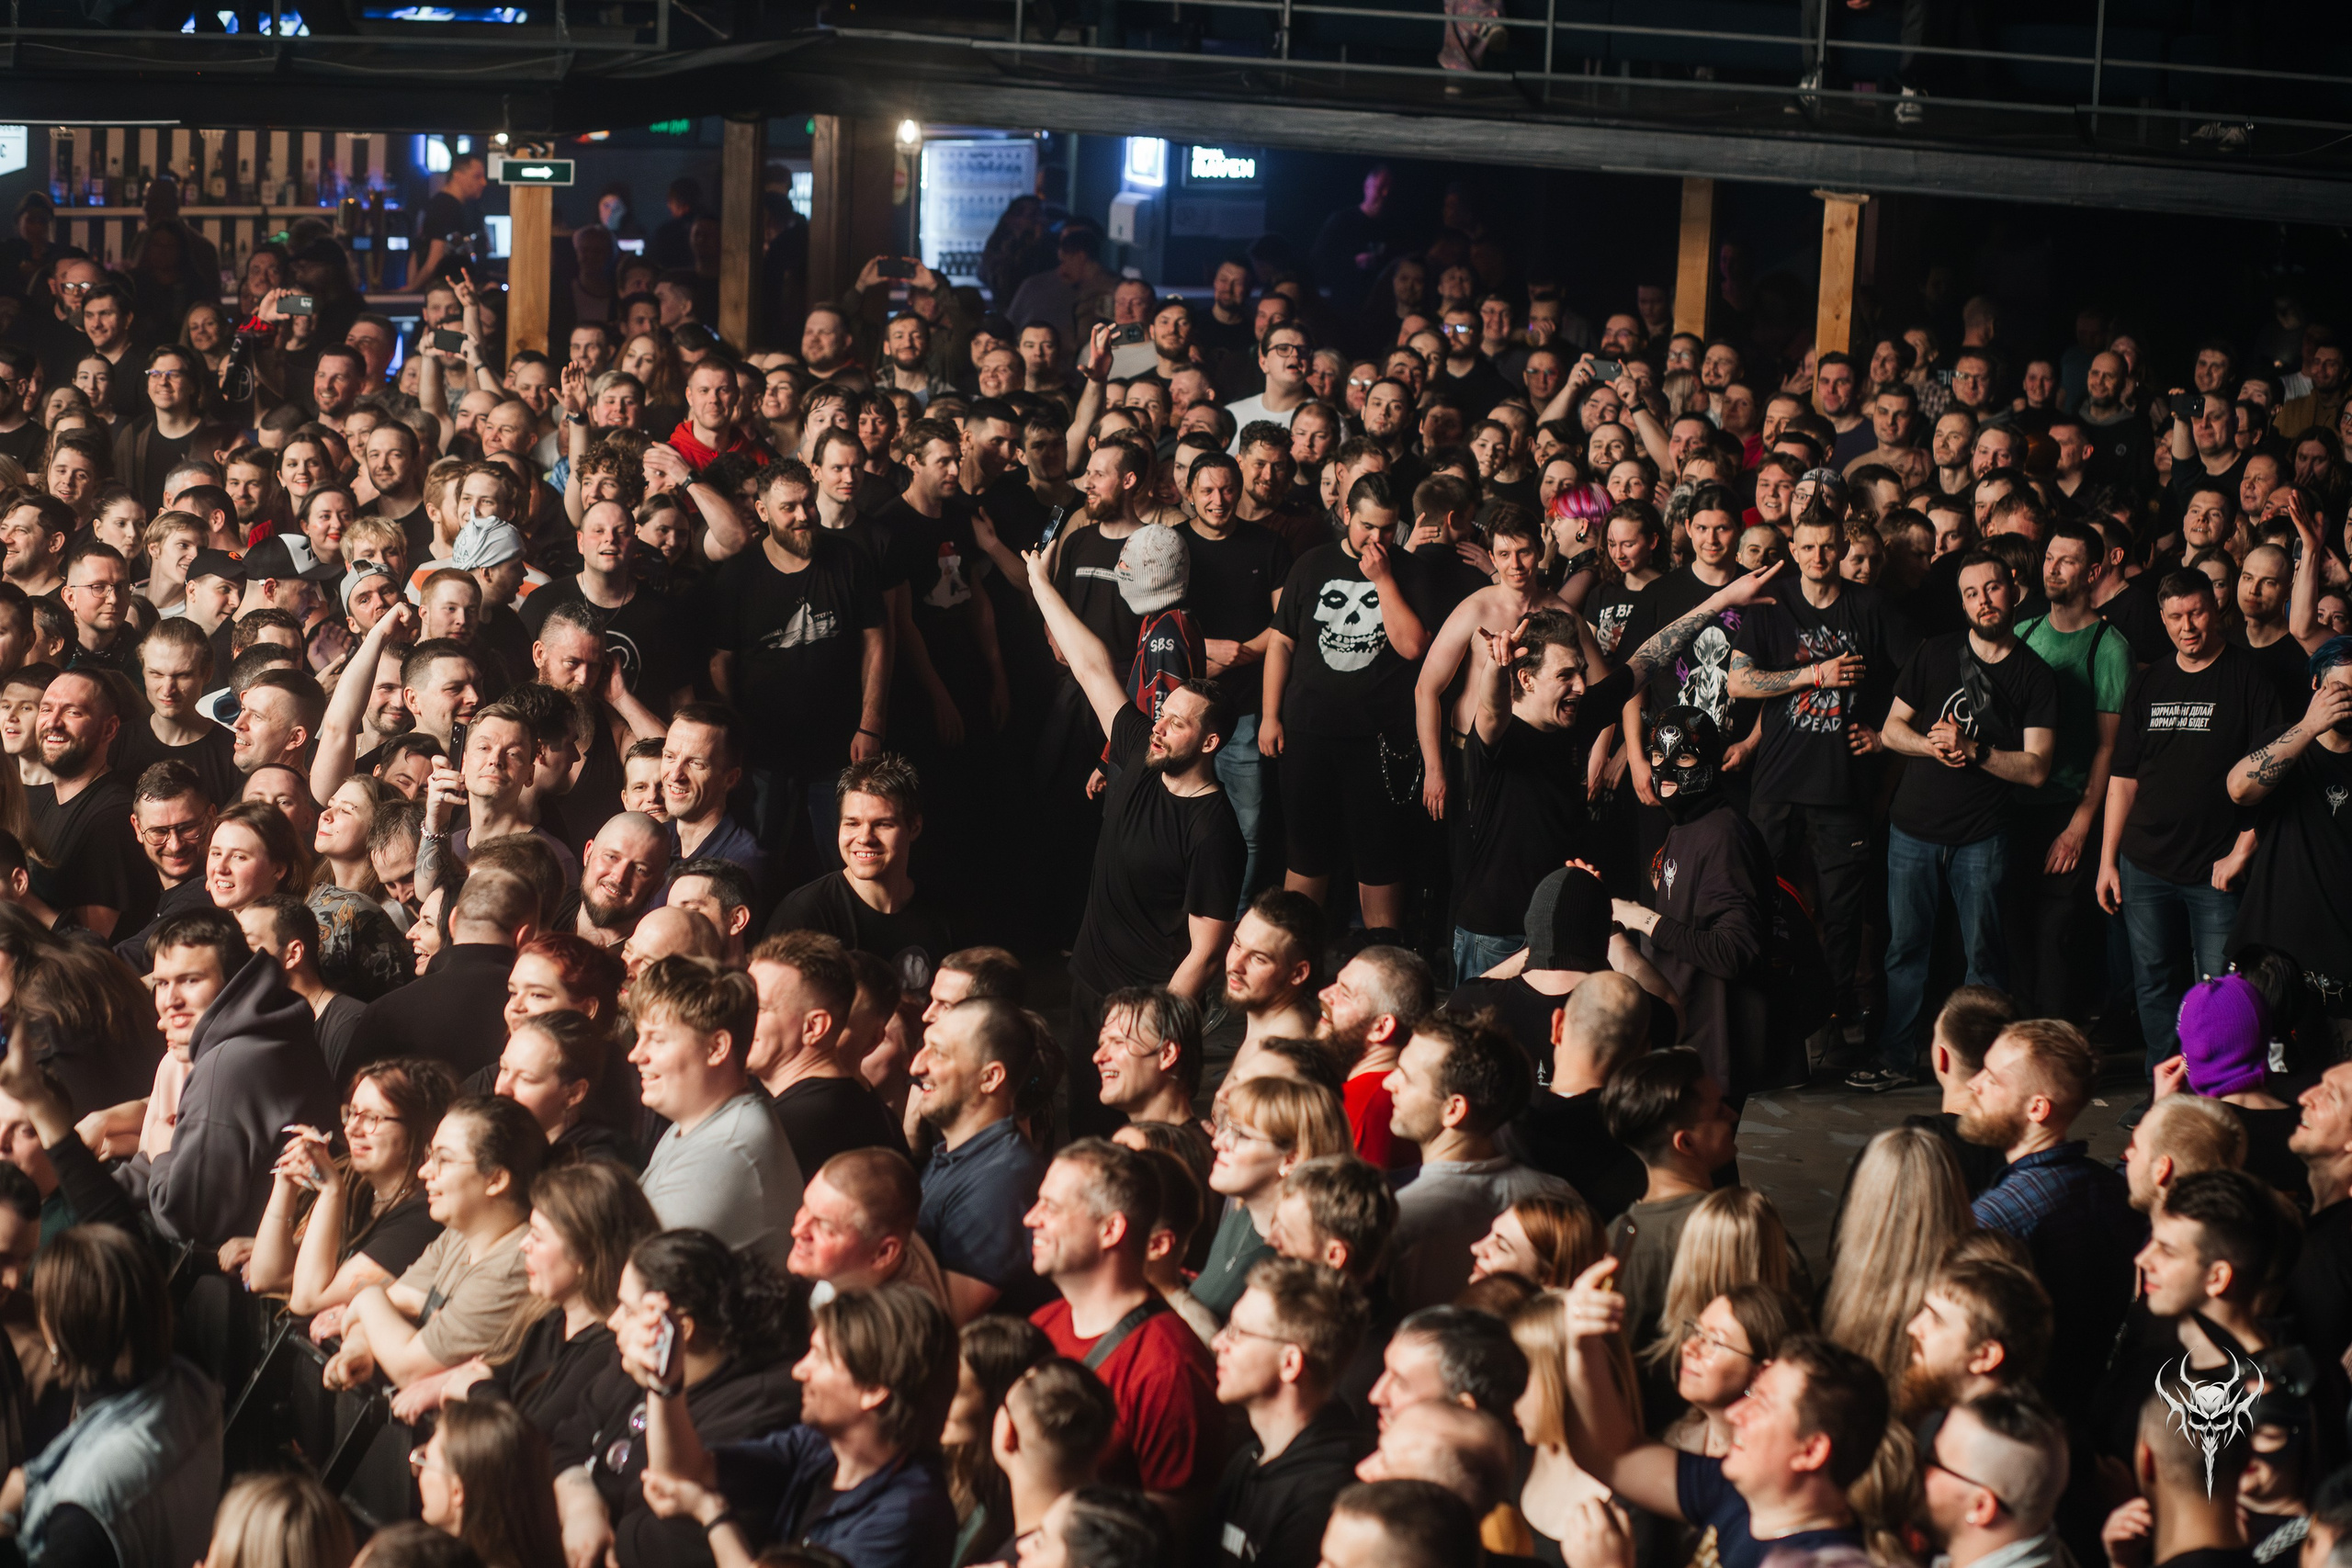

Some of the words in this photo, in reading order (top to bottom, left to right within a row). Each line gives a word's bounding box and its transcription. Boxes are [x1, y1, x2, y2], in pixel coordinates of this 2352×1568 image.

[1149, 637, 1175, 653] SBS
[2188, 704, 2214, 717] ДЕЛАЙ
[1799, 715, 1842, 734] DEAD
[2188, 717, 2211, 729] БУДЕТ
